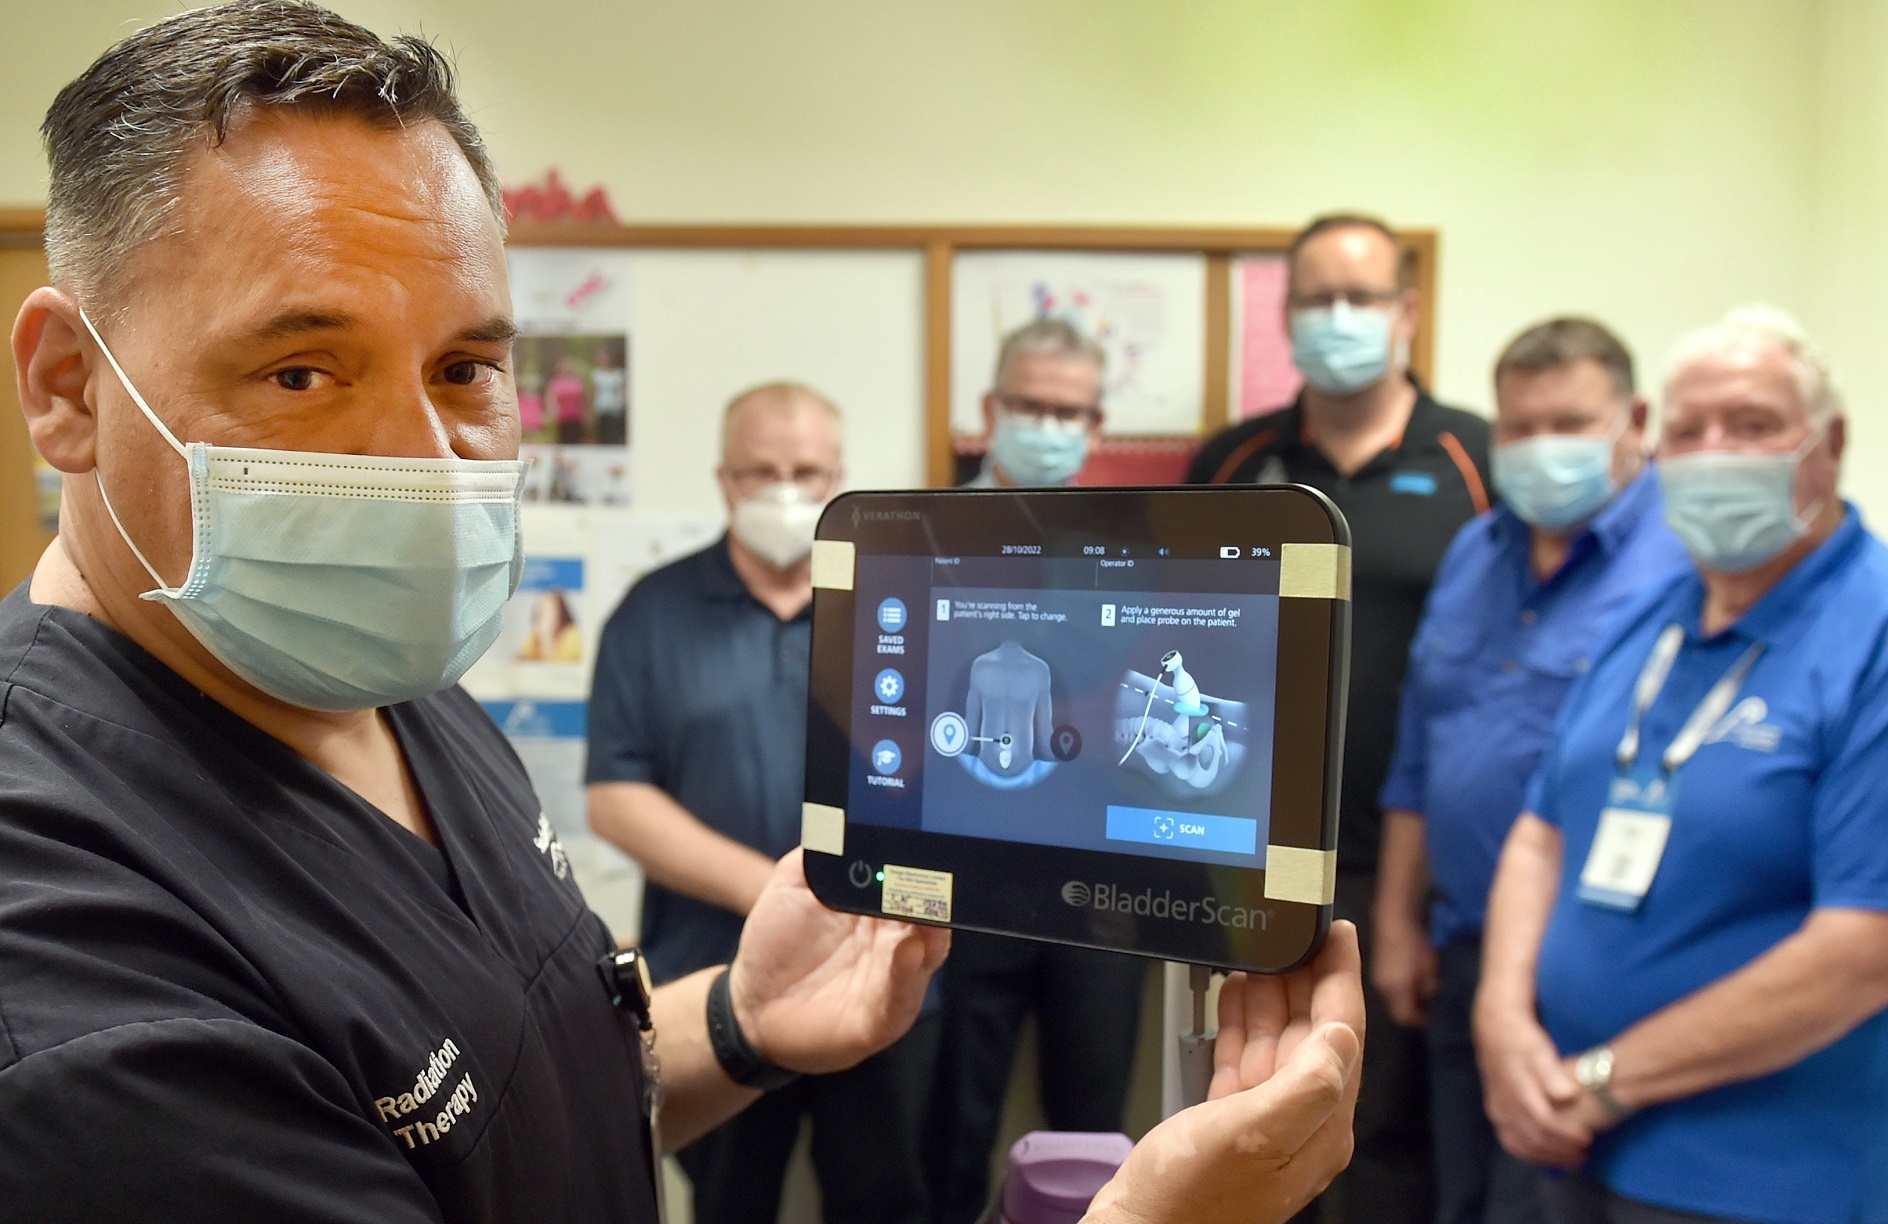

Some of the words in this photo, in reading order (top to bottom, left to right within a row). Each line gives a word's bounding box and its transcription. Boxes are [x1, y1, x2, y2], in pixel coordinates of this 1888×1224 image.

[862, 511, 920, 520] VERATHON
[1001, 545, 1041, 554] 28/10/2022
[1083, 546, 1105, 555] 09:08
[1251, 547, 1271, 557] 39%
[1100, 560, 1126, 568] Operator
[954, 600, 976, 610] You're
[976, 602, 1007, 612] scanning
[1007, 602, 1024, 611] from
[1025, 602, 1037, 611] the
[953, 610, 982, 619] patient's
[983, 611, 1000, 620] right
[1018, 612, 1030, 621] Tap
[1039, 613, 1067, 623] change.
[1105, 608, 1112, 619] 2
[1121, 605, 1143, 616] Apply
[1150, 608, 1185, 618] generous
[1186, 607, 1216, 617] amount
[1217, 607, 1227, 617] of
[1228, 608, 1240, 619] gel
[1120, 615, 1135, 624] and
[1136, 616, 1156, 626] place
[1157, 616, 1180, 626] probe
[1181, 618, 1191, 626] on
[1193, 617, 1206, 627] the
[1207, 617, 1237, 628] patient.
[878, 634, 904, 645] SAVED
[877, 644, 905, 655] EXAMS
[870, 705, 907, 716] SETTINGS
[867, 775, 905, 788] TUTORIAL
[1179, 823, 1205, 836] SCAN
[1093, 883, 1267, 931] BladderScan
[374, 1038, 460, 1123] Radiation
[393, 1071, 478, 1150] Therapy
